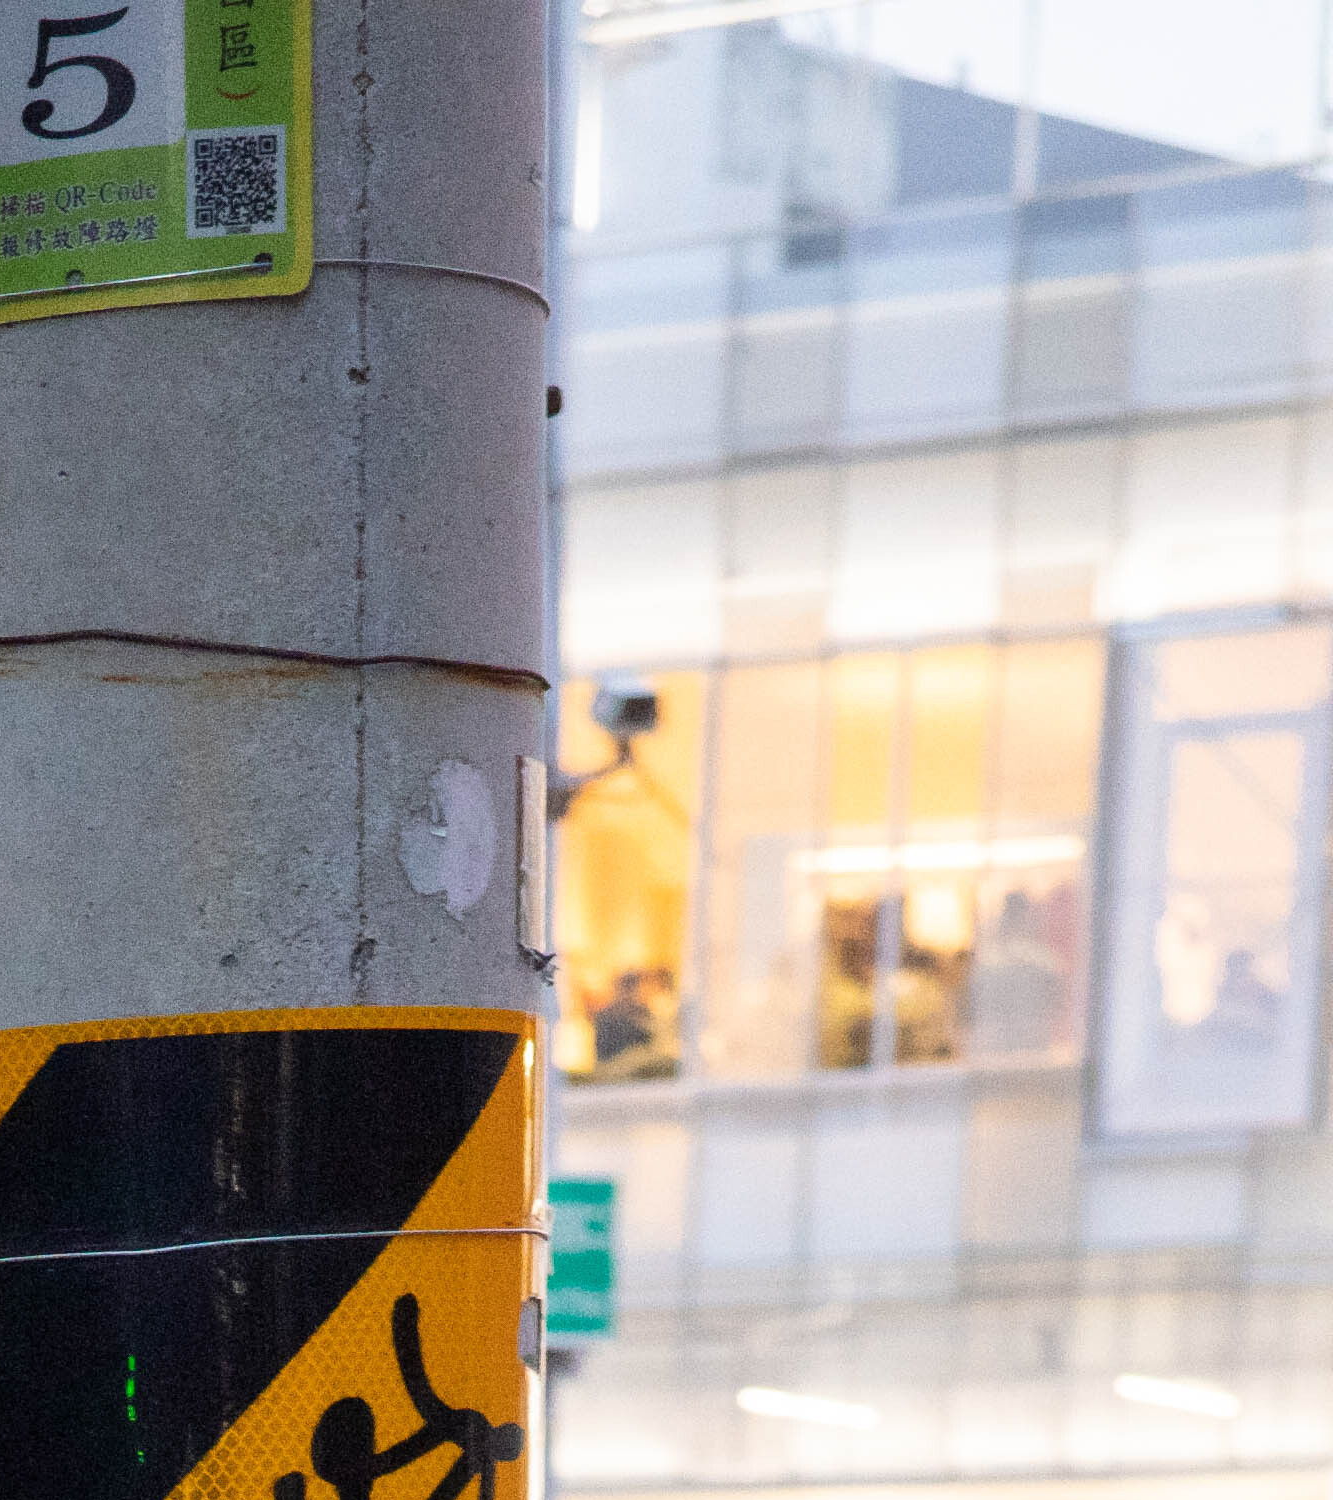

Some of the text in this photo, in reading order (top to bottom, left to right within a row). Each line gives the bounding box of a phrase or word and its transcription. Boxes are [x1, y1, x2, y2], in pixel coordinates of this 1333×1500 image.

[21, 6, 137, 140] 5
[54, 179, 158, 214] QR-Code
[0, 215, 159, 259] 報修故障路燈
